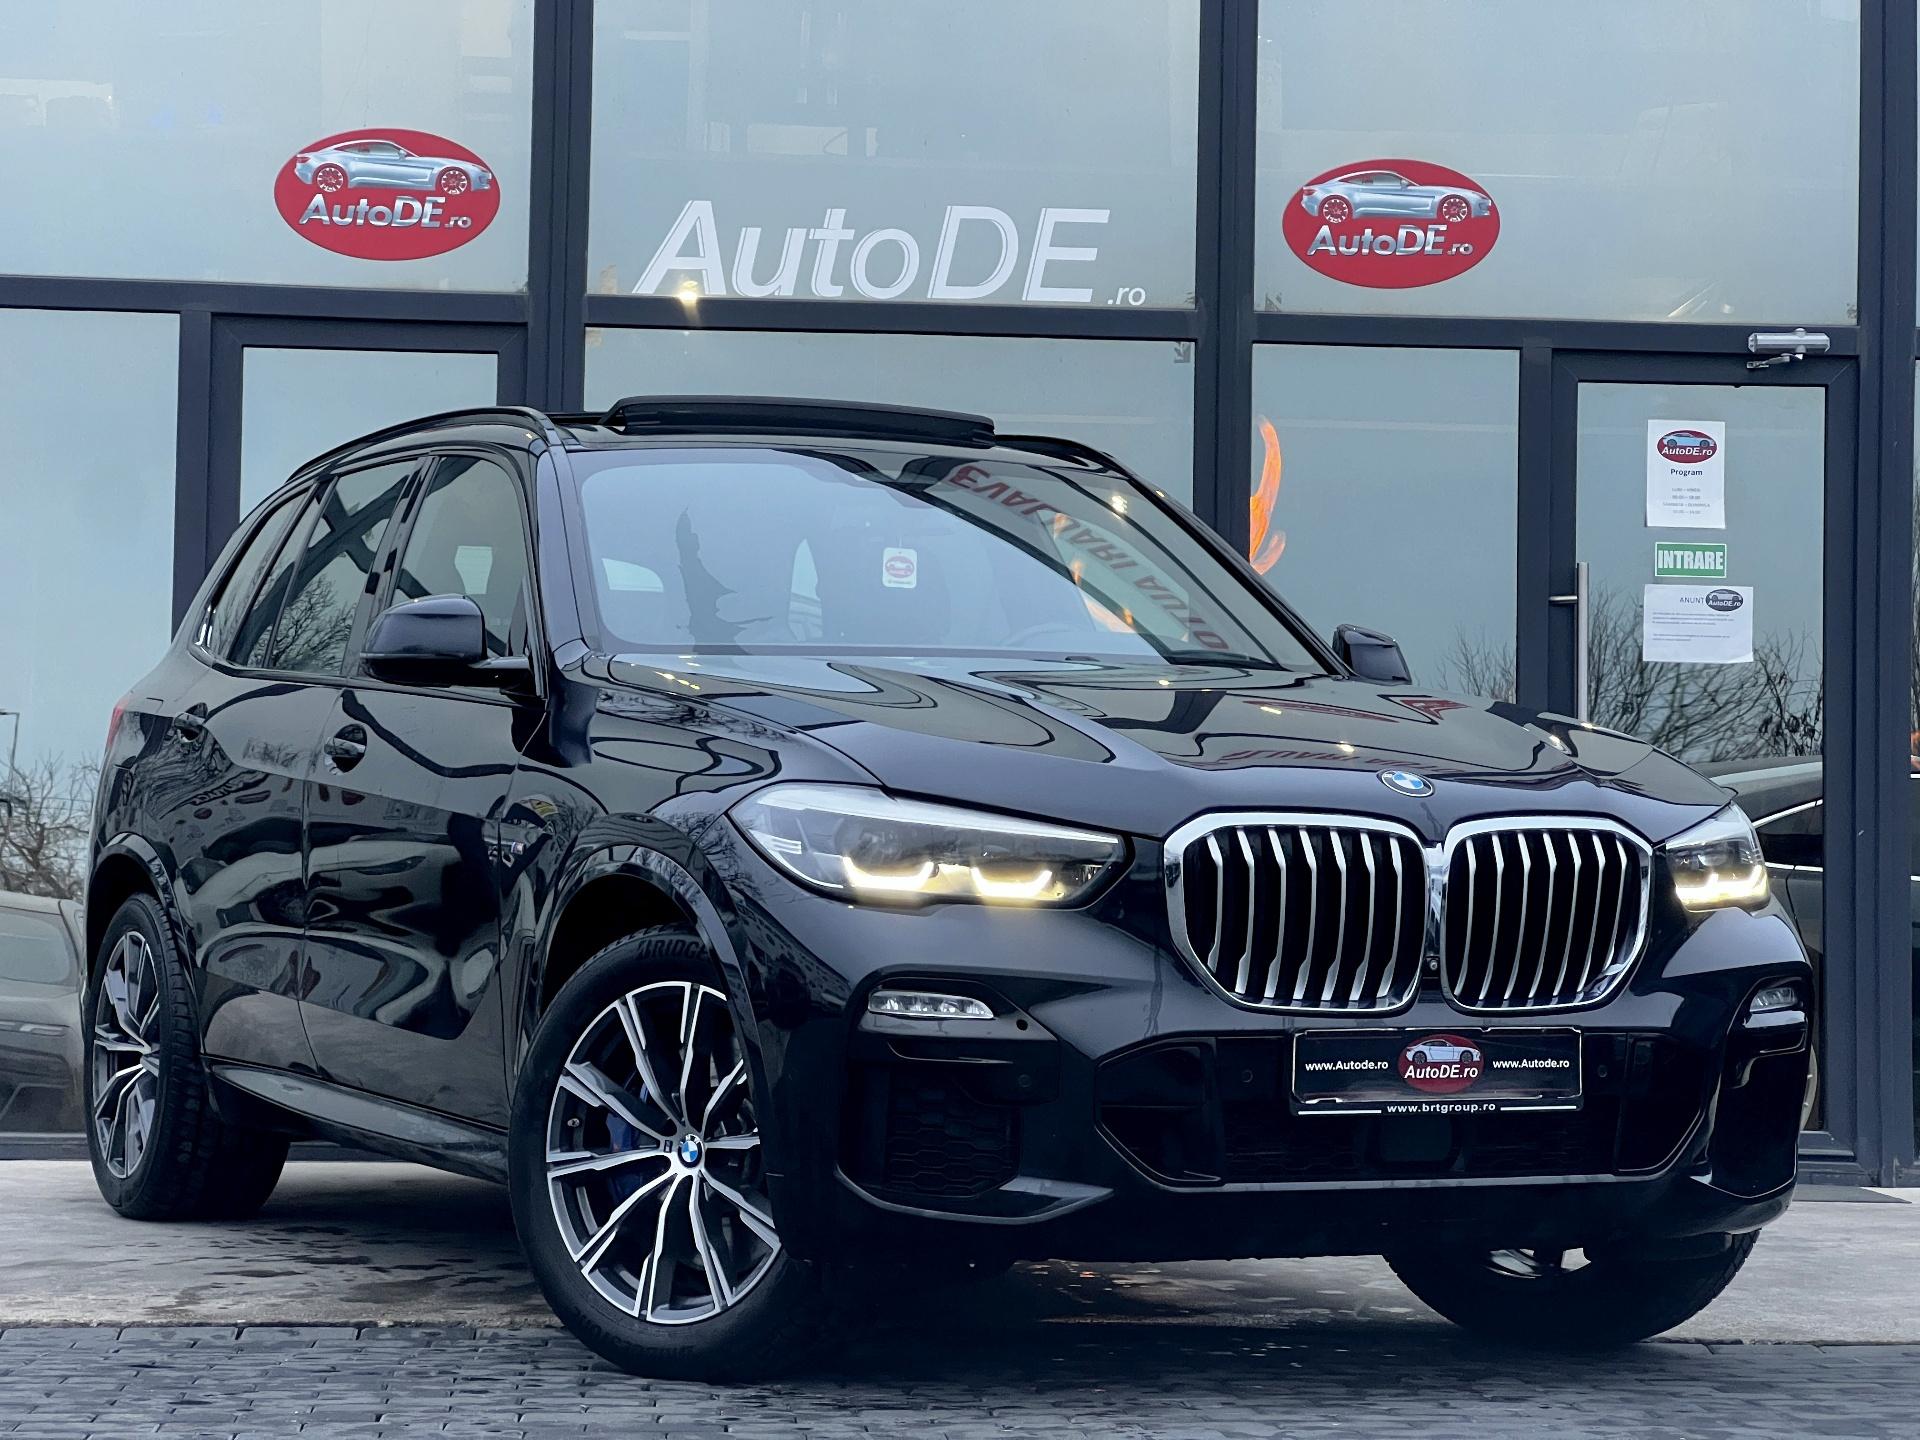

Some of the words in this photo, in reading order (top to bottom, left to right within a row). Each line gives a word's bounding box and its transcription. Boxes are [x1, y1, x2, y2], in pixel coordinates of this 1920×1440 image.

[1661, 446, 1713, 456] AutoDE.ro
[1670, 468, 1703, 477] Program
[1657, 550, 1724, 570] INTRARE
[1305, 1059, 1389, 1071] www.Autode.ro
[1492, 1058, 1570, 1070] www.Autode.ro
[1404, 1064, 1479, 1080] AutoDE.ro
[1387, 1102, 1496, 1114] www.brtgroup.ro
